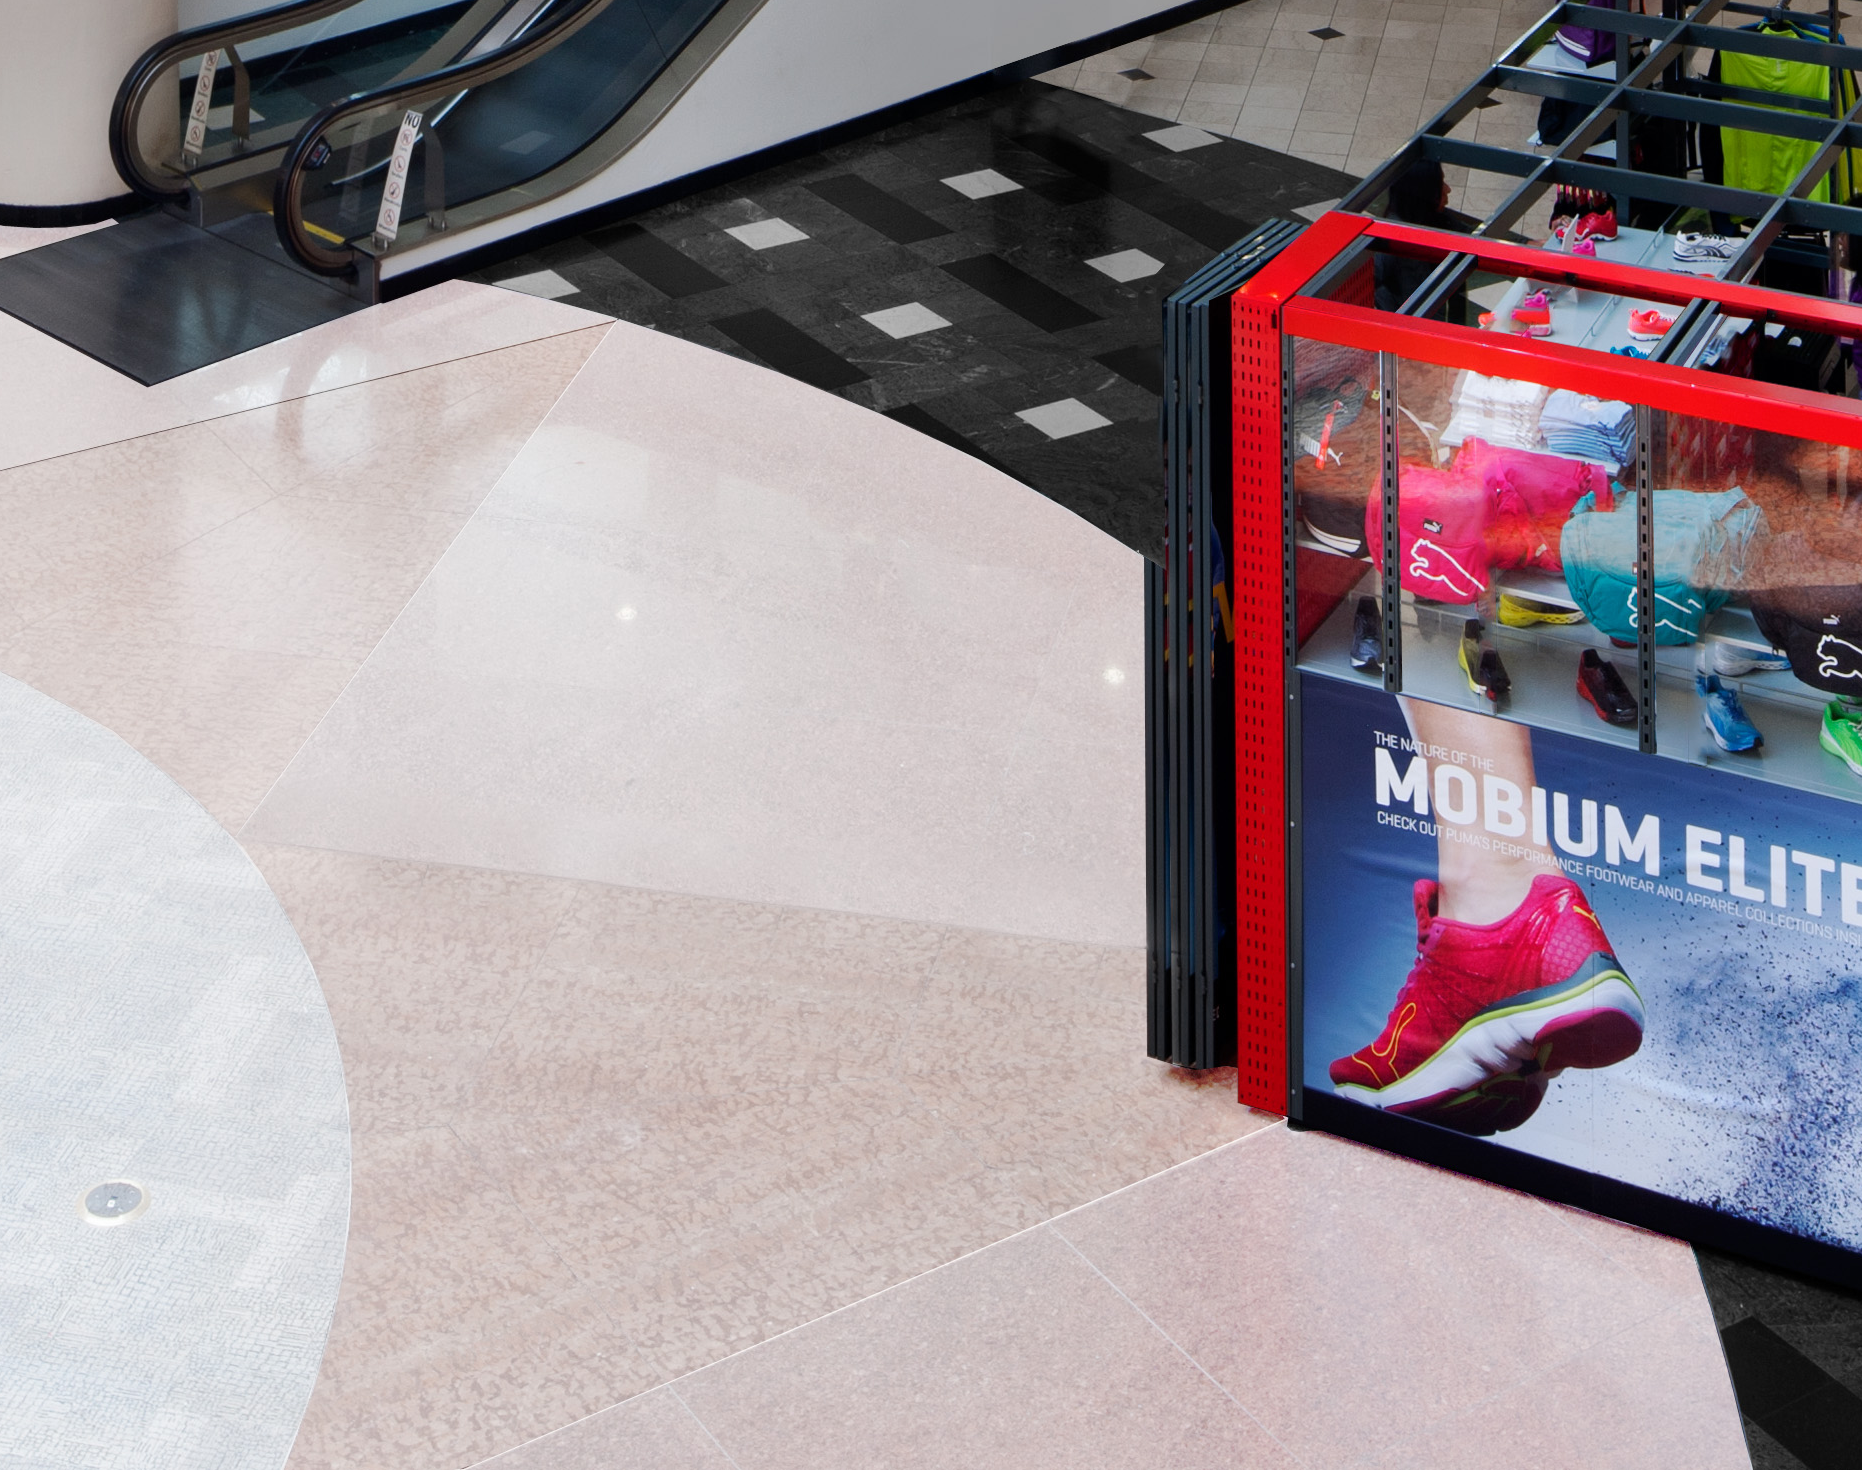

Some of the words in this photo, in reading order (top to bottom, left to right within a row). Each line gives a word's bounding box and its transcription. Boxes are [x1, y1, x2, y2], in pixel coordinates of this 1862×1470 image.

[1373, 730, 1397, 749] THE
[1400, 736, 1449, 761] NATURE
[1451, 748, 1468, 765] OF
[1470, 752, 1494, 772] THE
[1374, 747, 1661, 878] MOBIUM
[1377, 811, 1417, 833] CHECK
[1419, 821, 1444, 838] OUT
[1446, 826, 1490, 850] PUMA'S
[1493, 840, 1584, 876] PERFORMANCE
[1586, 862, 1655, 894] FOOTWEAR
[1657, 881, 1683, 901] AND
[1686, 889, 1743, 917] APPAREL
[1745, 906, 1833, 940] COLLECTIONS
